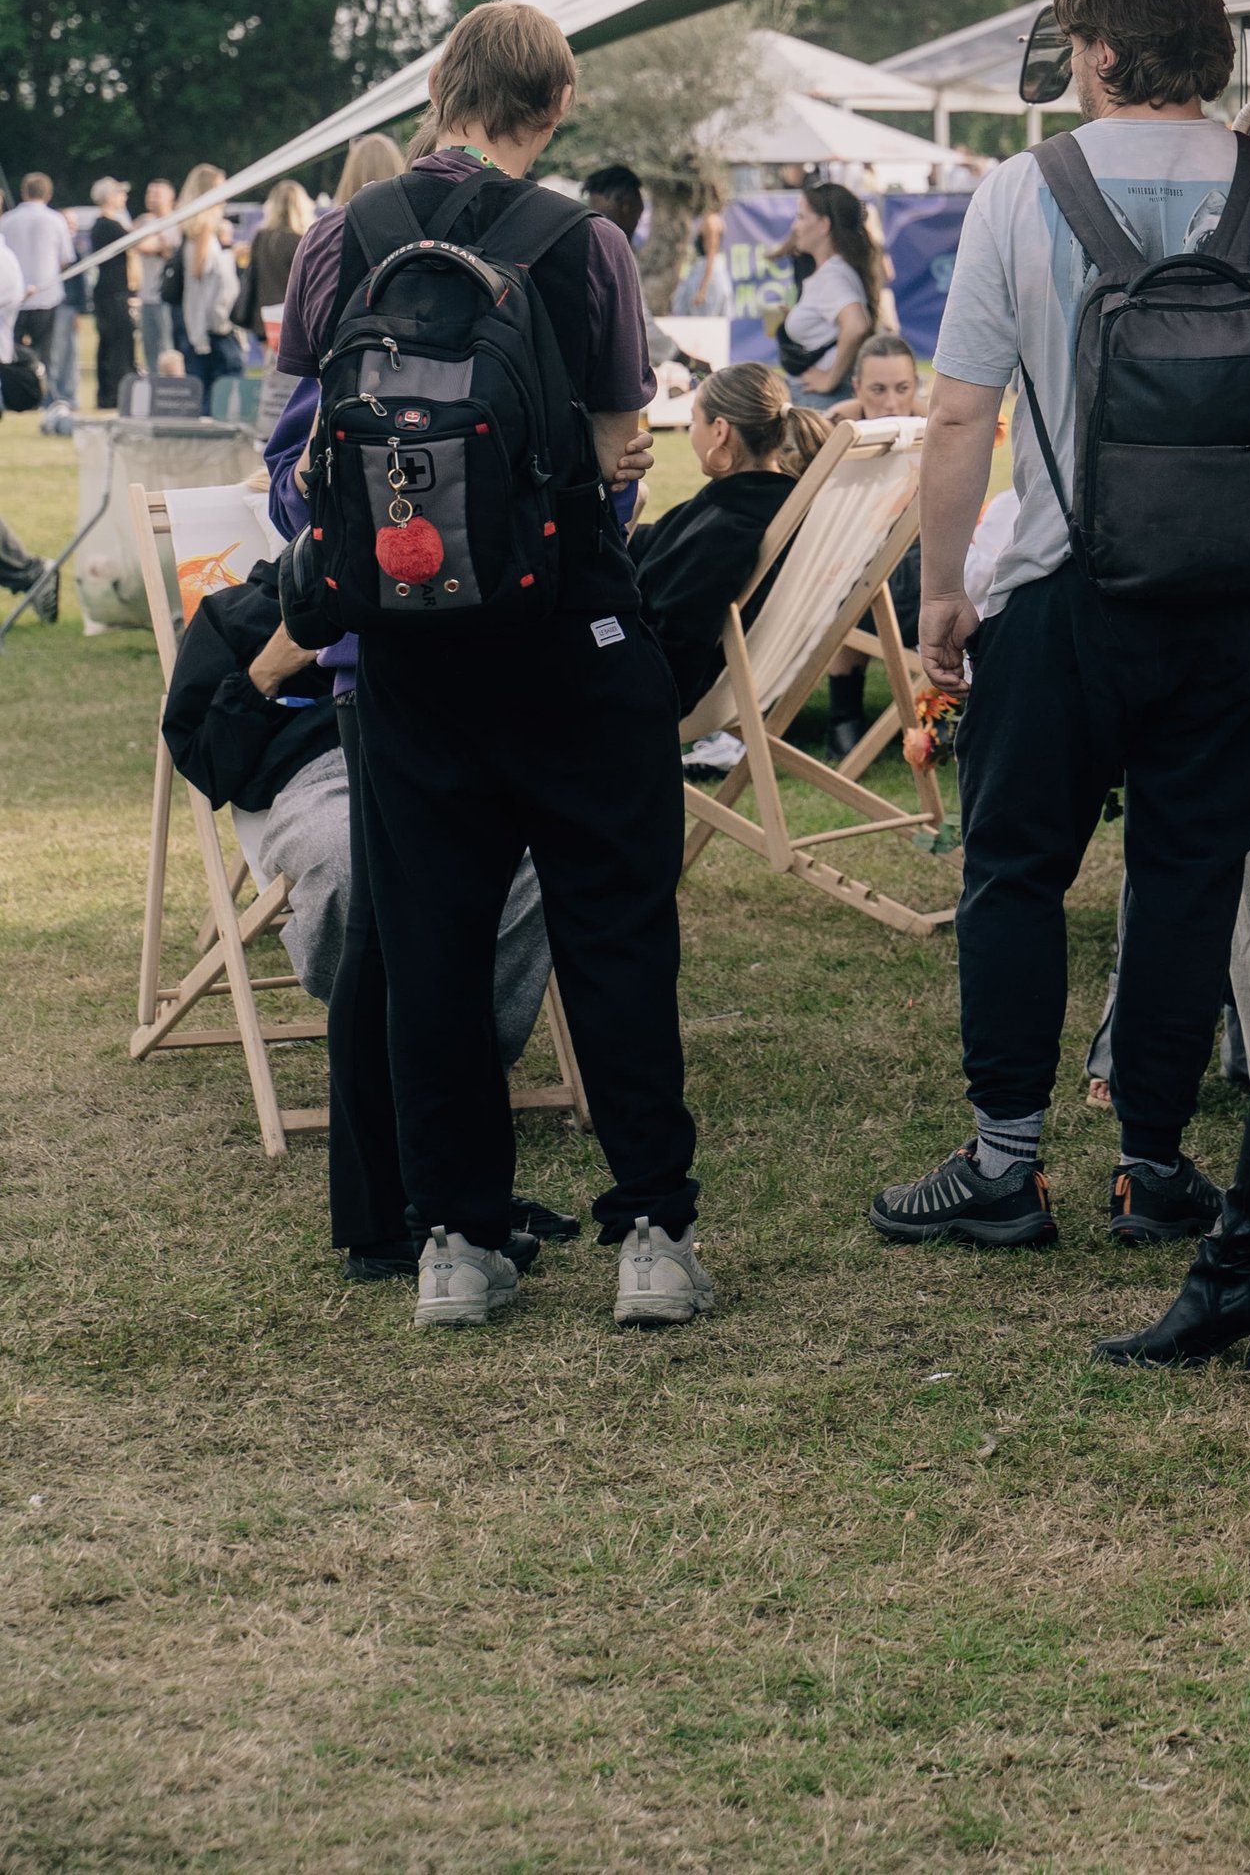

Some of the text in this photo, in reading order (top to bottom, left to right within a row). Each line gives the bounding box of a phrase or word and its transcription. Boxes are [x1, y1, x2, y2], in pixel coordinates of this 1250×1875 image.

[1128, 187, 1157, 195] UNIVERSAL
[382, 243, 477, 267] SWISS GEAR
